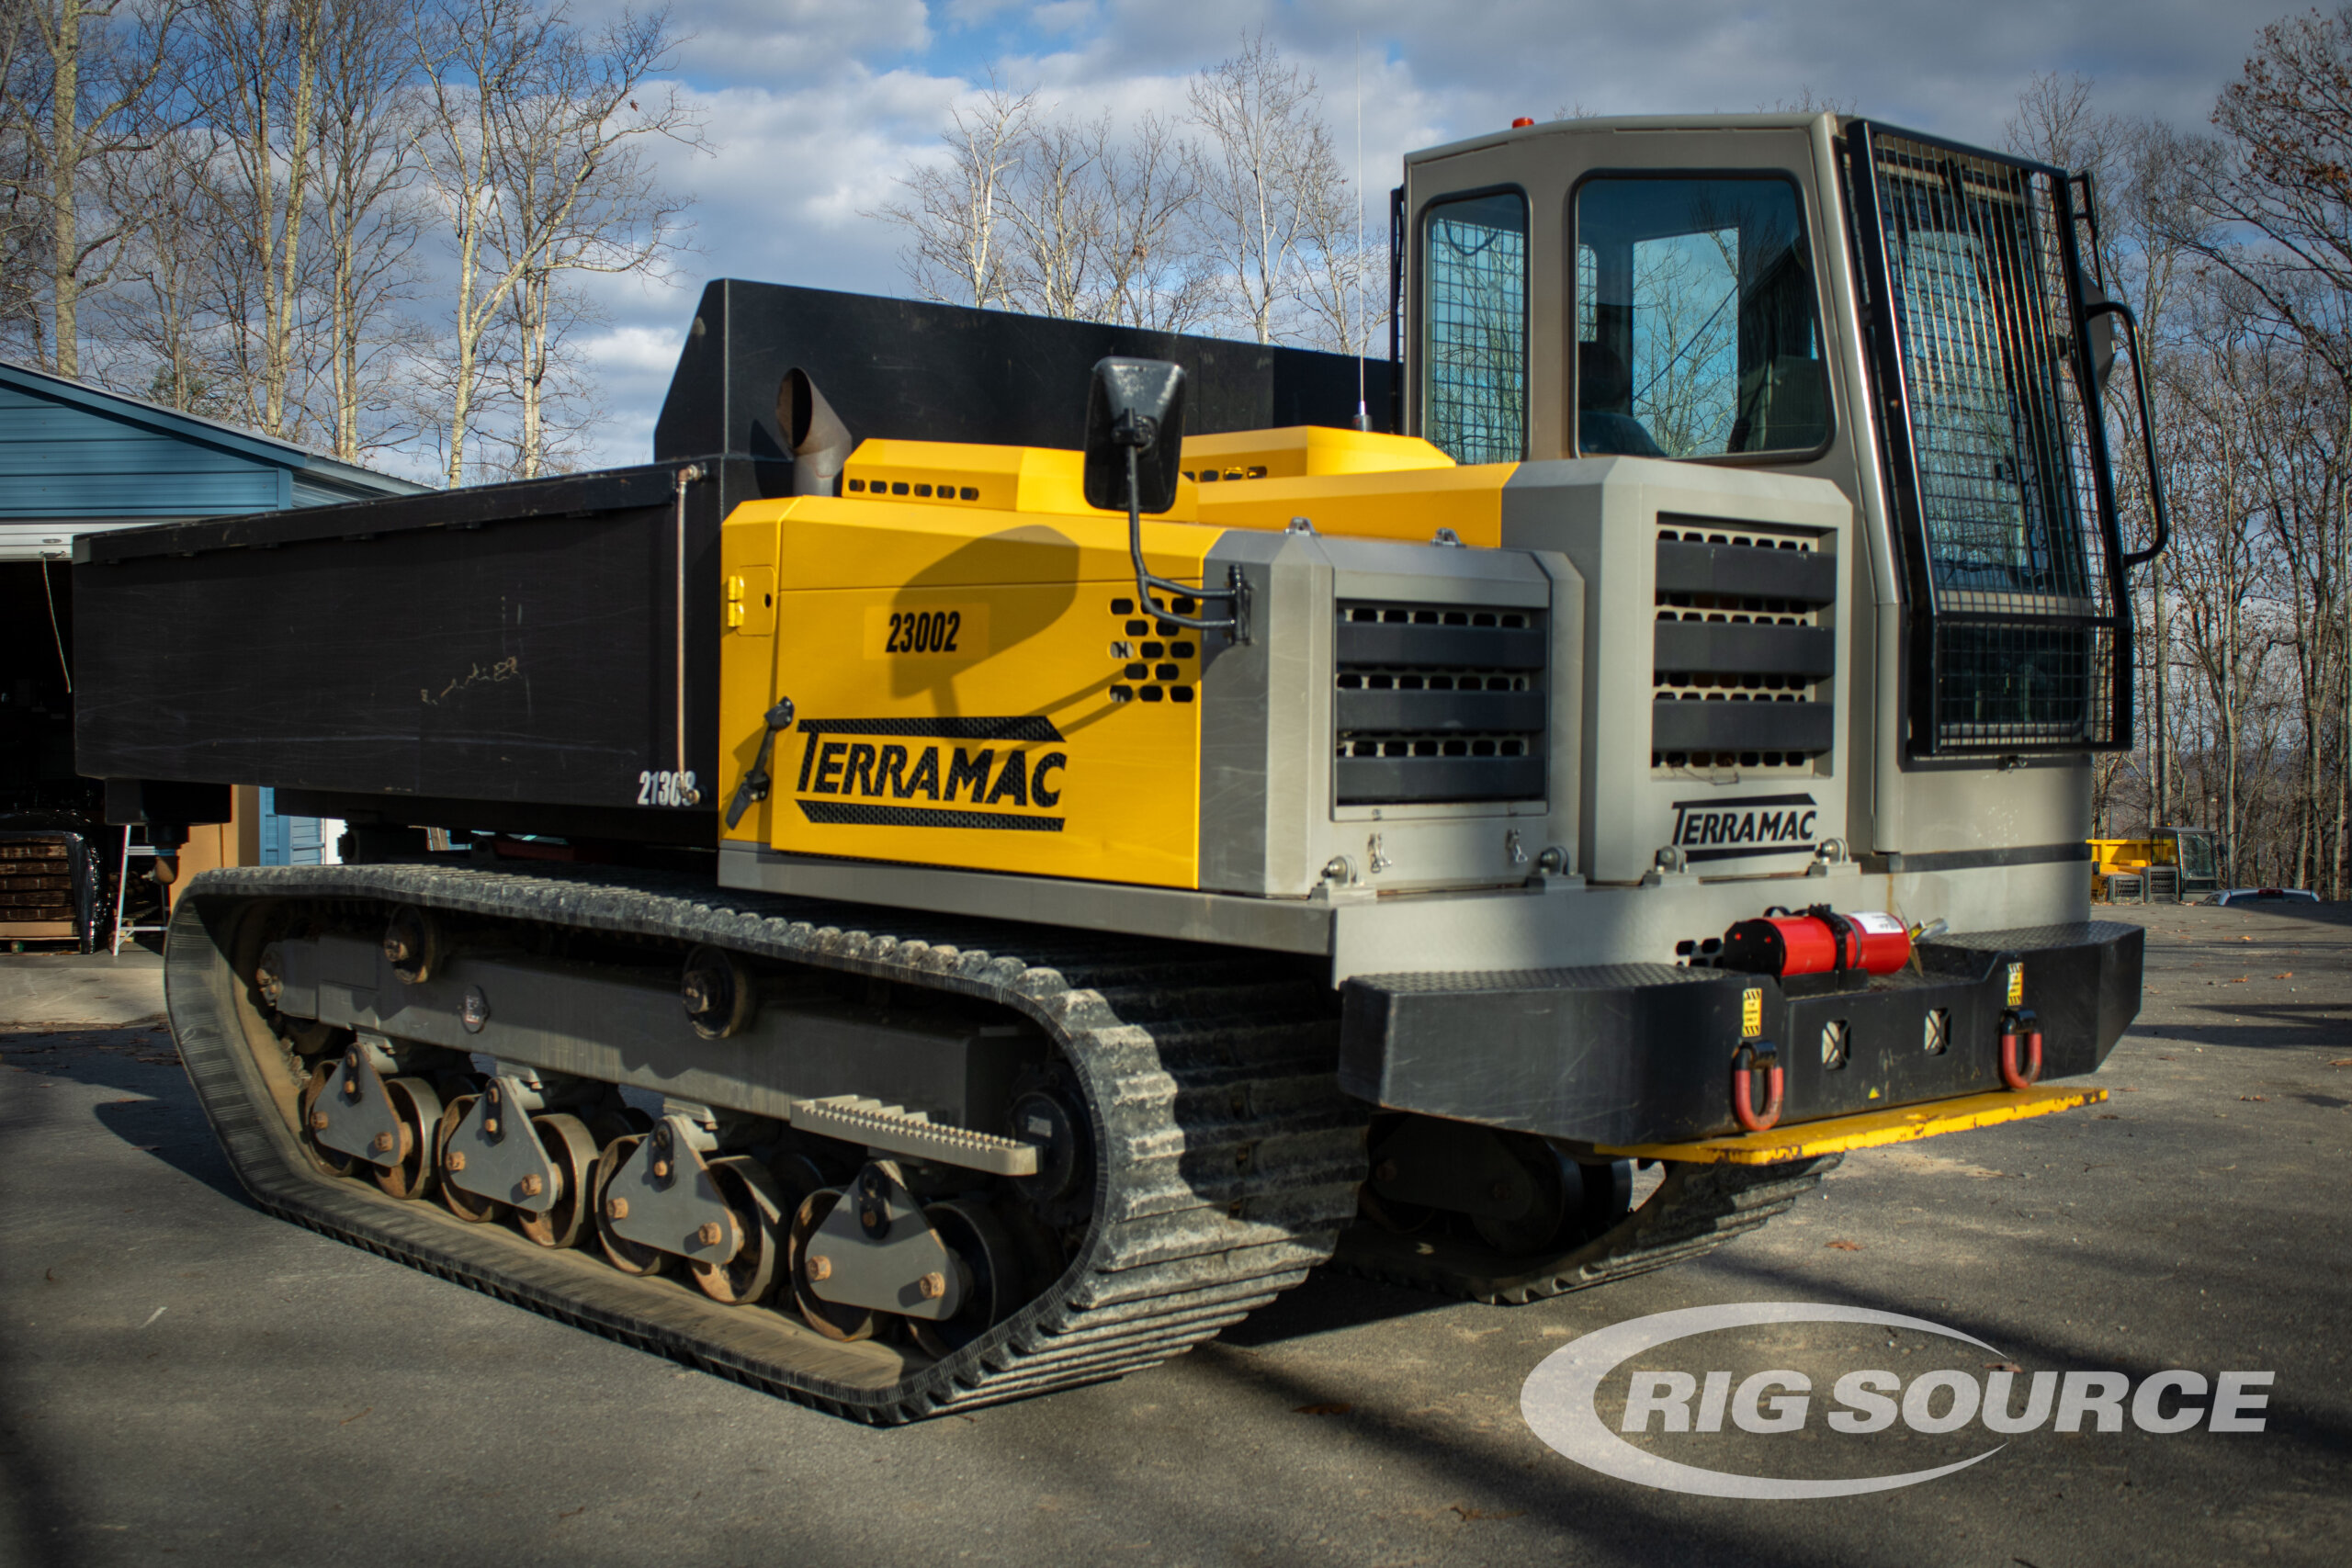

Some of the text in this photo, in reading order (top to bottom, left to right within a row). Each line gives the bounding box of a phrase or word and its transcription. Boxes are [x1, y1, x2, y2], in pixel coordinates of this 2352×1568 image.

[885, 611, 961, 653] 23002
[797, 716, 1068, 808] TERRAMAC
[1671, 793, 1818, 846] TERRAMAC
